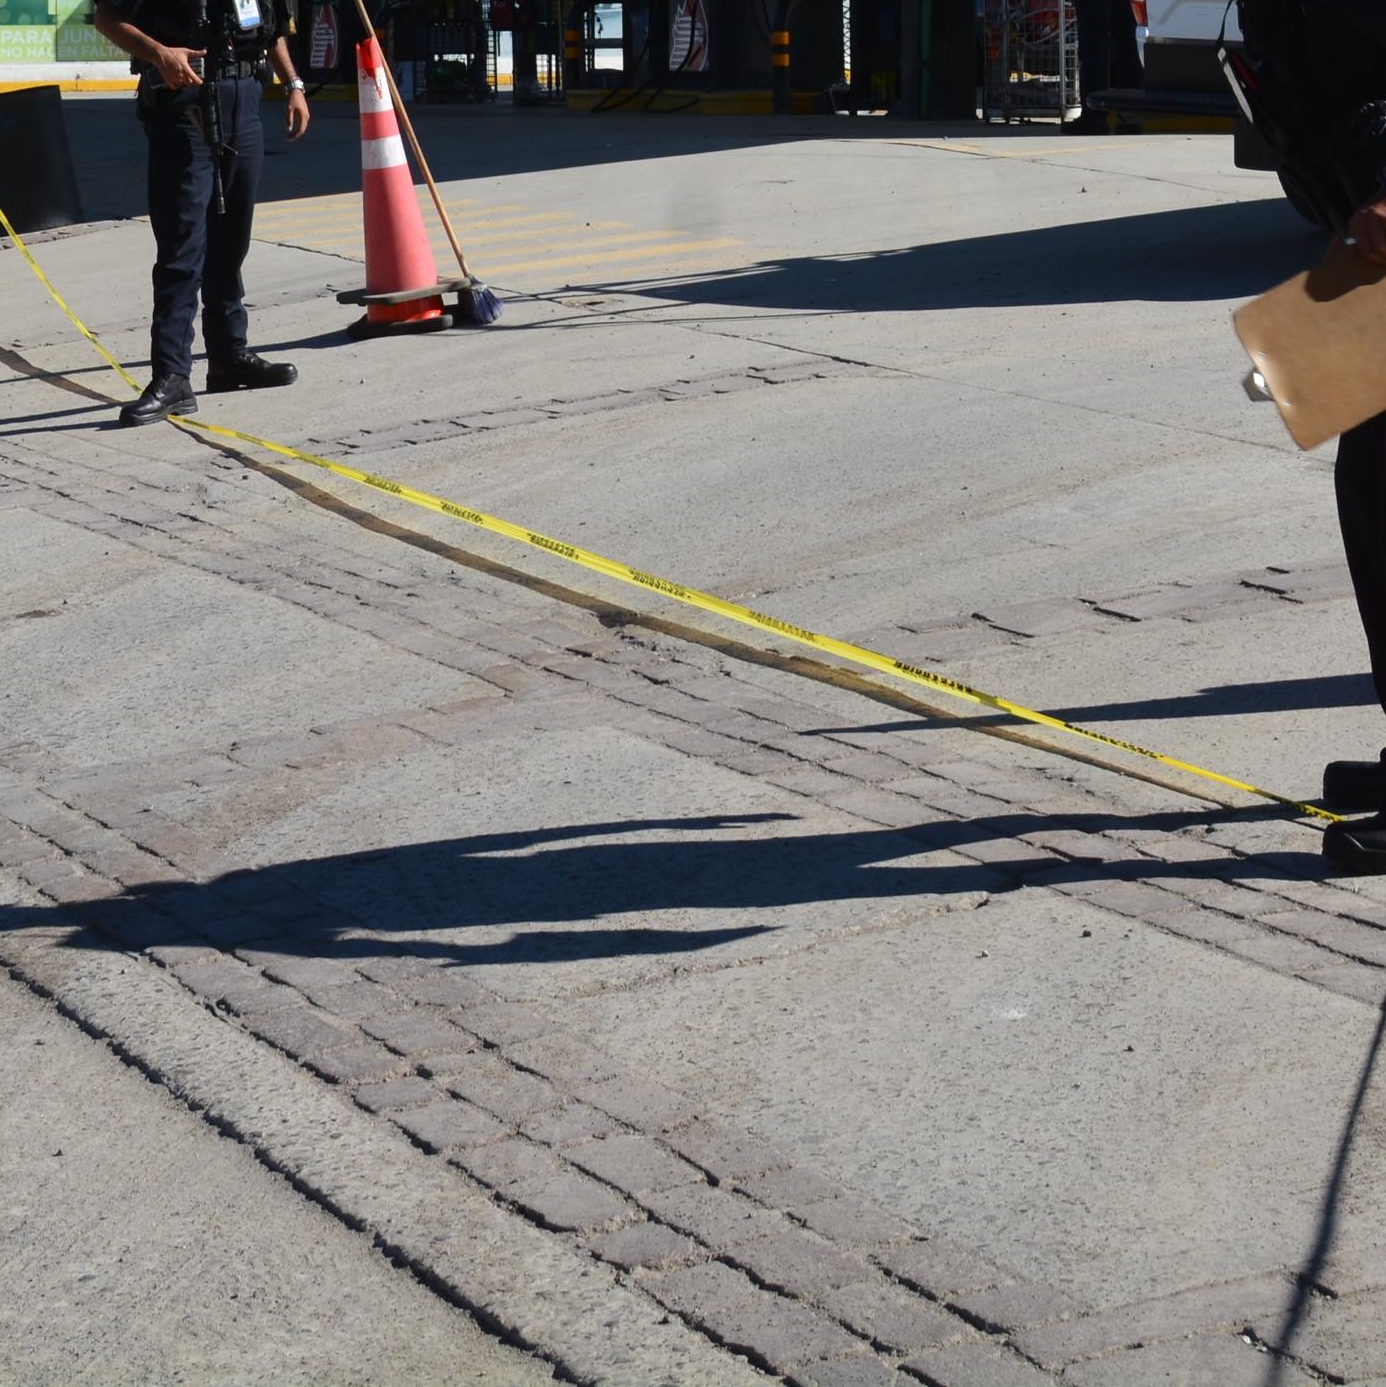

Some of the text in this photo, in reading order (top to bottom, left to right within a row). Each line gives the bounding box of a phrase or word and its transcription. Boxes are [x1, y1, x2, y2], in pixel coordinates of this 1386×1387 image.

[0, 29, 53, 44] PARA
[0, 47, 23, 59] NO
[26, 46, 77, 59] HACEN
